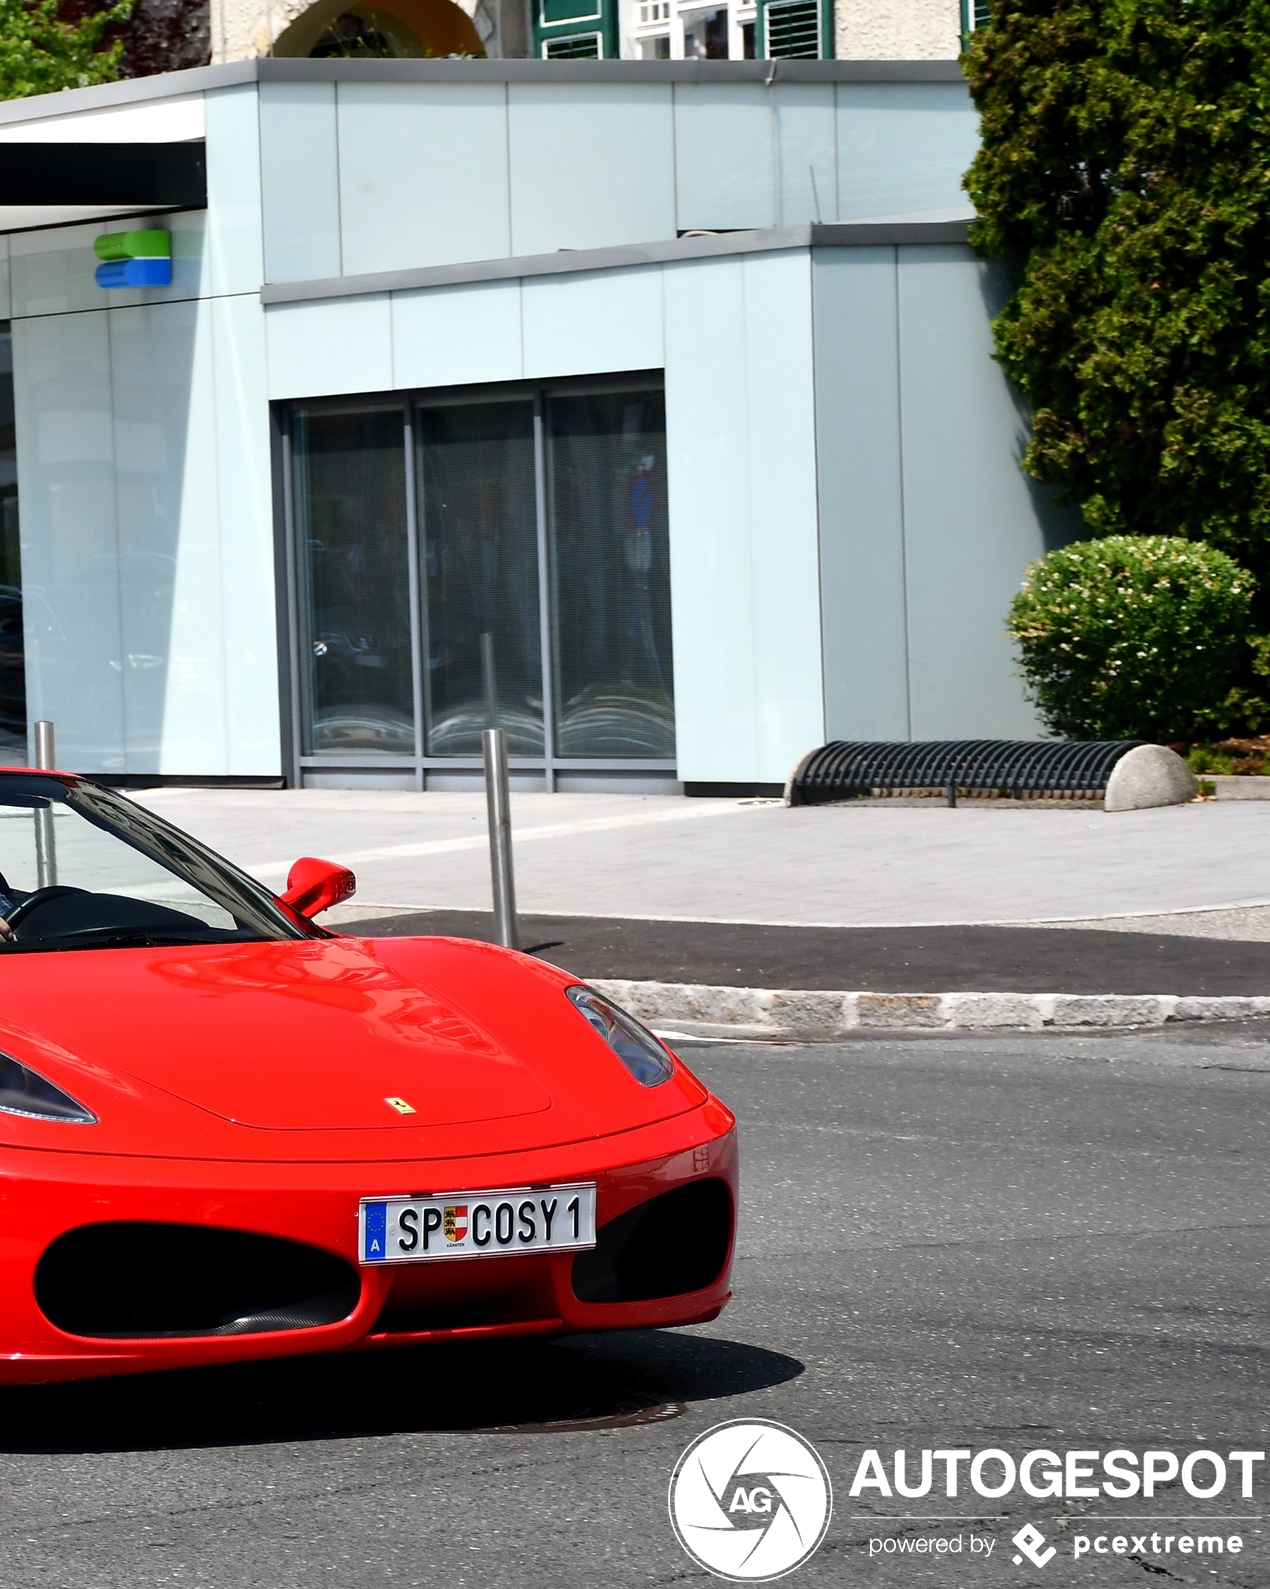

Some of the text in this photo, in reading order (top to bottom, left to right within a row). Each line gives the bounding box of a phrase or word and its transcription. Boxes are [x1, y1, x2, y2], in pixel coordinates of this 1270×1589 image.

[398, 1195, 580, 1251] SP COSY 1
[370, 1238, 381, 1252] A
